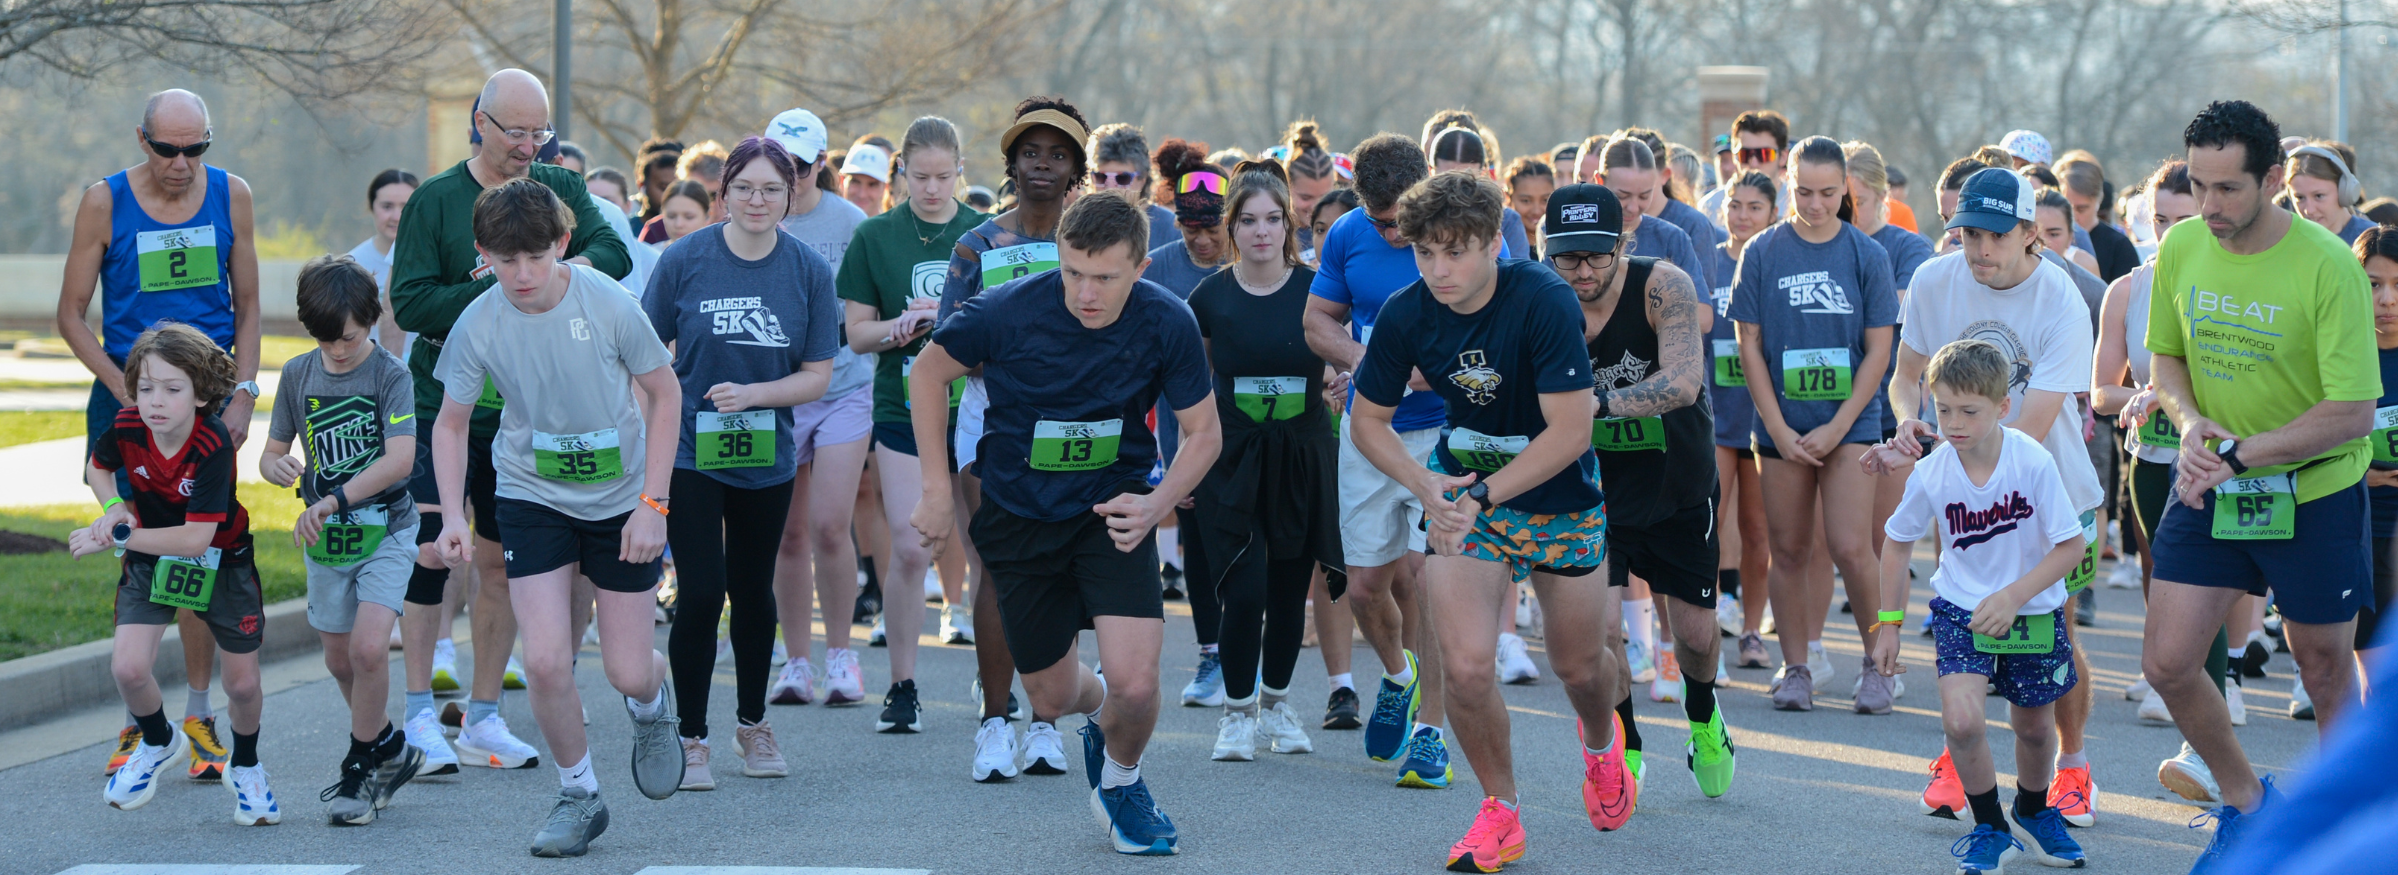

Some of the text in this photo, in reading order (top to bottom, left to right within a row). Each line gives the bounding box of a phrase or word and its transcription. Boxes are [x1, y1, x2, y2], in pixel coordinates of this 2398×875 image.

[1983, 197, 1997, 206] BIG
[1998, 200, 2014, 211] SUR
[169, 251, 187, 278] 2
[148, 277, 212, 288] PAPE-DAWSON
[1778, 271, 1829, 290] CHARGERS
[700, 296, 761, 313] CHARGERS
[1789, 284, 1815, 307] 5K
[2198, 290, 2283, 324] BEAT
[712, 310, 745, 335] 5K
[1967, 321, 1988, 334] COLONY
[1989, 321, 2011, 335] COUGAR
[2010, 333, 2027, 357] CLASSIC
[2197, 329, 2274, 351] BRENTWOOD
[2198, 341, 2274, 363] ENDURANCE
[2201, 355, 2256, 372] ATHLETIC
[2201, 367, 2234, 382] TEAM
[1799, 368, 1836, 391] 178
[1262, 398, 1277, 421] 7
[315, 411, 379, 471] NIKE
[1605, 420, 1644, 443] 70
[2143, 435, 2181, 446] PAPE-DAW
[718, 432, 753, 458] 36
[1060, 440, 1093, 462] 13
[557, 452, 597, 475] 35
[703, 458, 768, 467] PAPE-DAWSON
[1038, 460, 1110, 468] PAPE-DAWSON
[545, 471, 616, 482] PAPE-DAWSON
[2236, 495, 2274, 527] 65
[326, 527, 363, 555] 62
[165, 564, 206, 598] 66
[1980, 642, 2048, 650] PAPE-DAWSON
